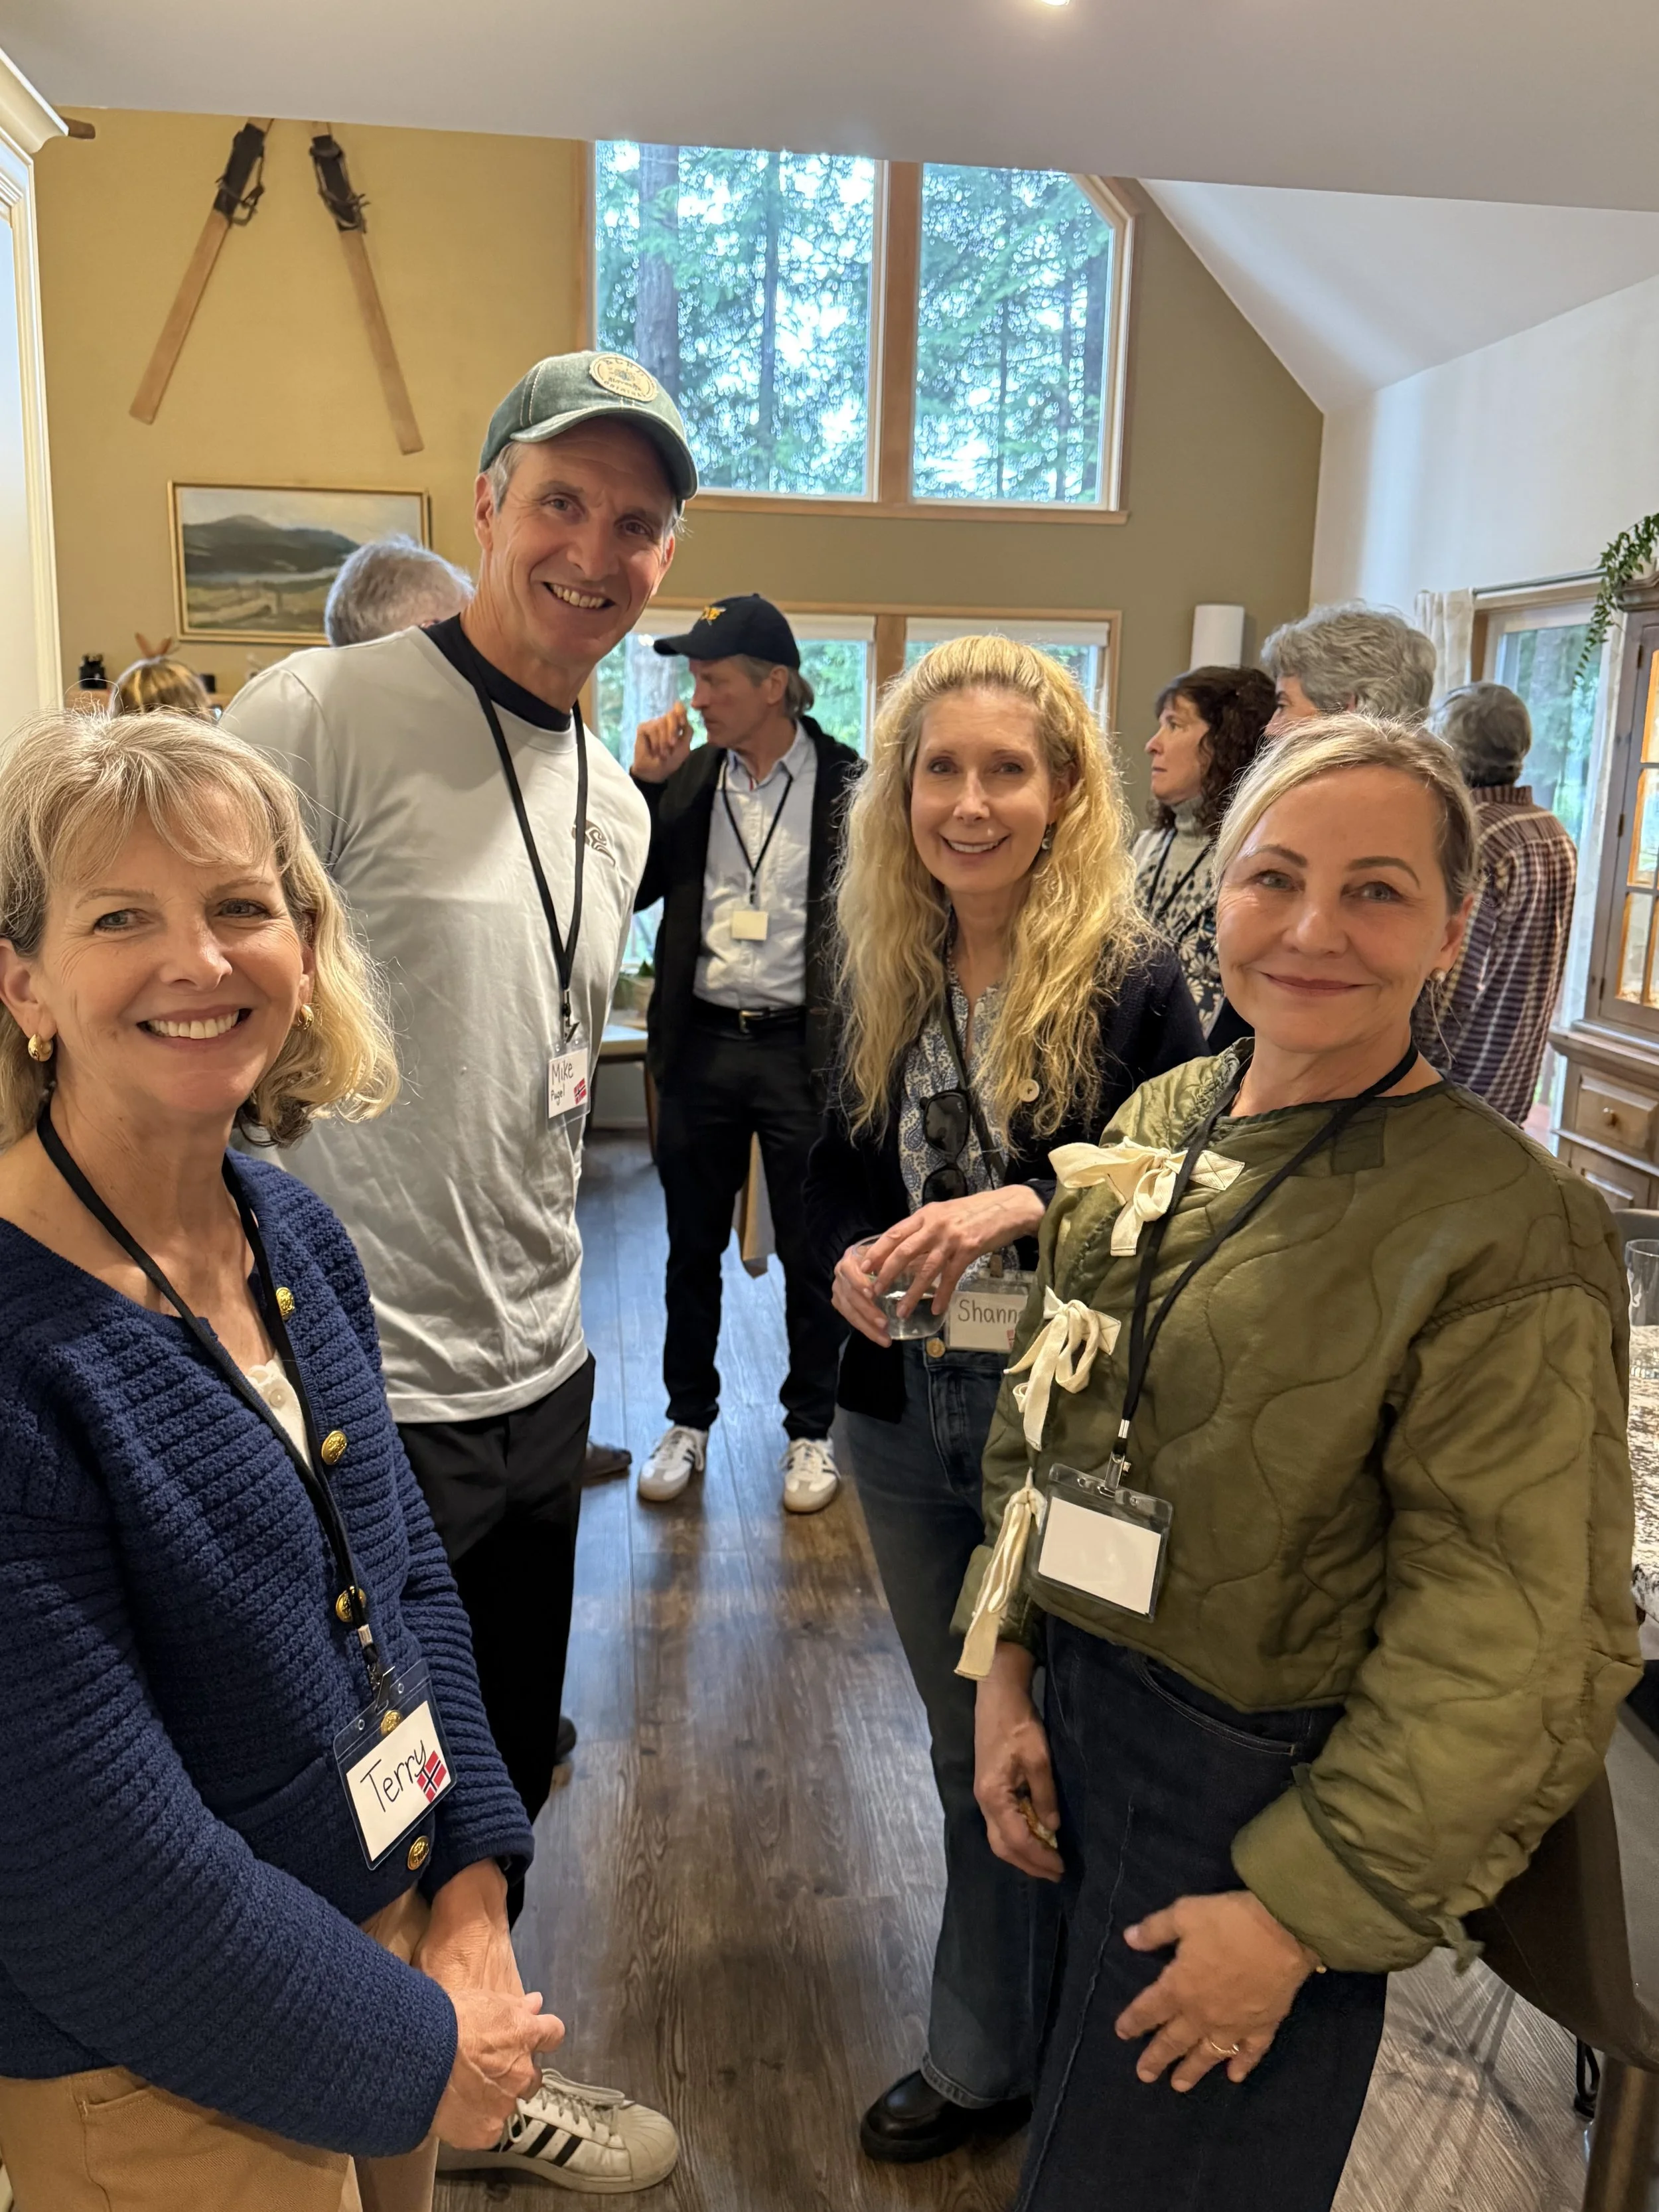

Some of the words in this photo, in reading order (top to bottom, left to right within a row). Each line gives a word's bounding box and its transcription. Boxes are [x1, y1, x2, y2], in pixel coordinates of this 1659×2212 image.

[551, 1060, 574, 1085] Mike
[958, 1299, 1019, 1324] Shann
[360, 1739, 426, 1812] Terry
